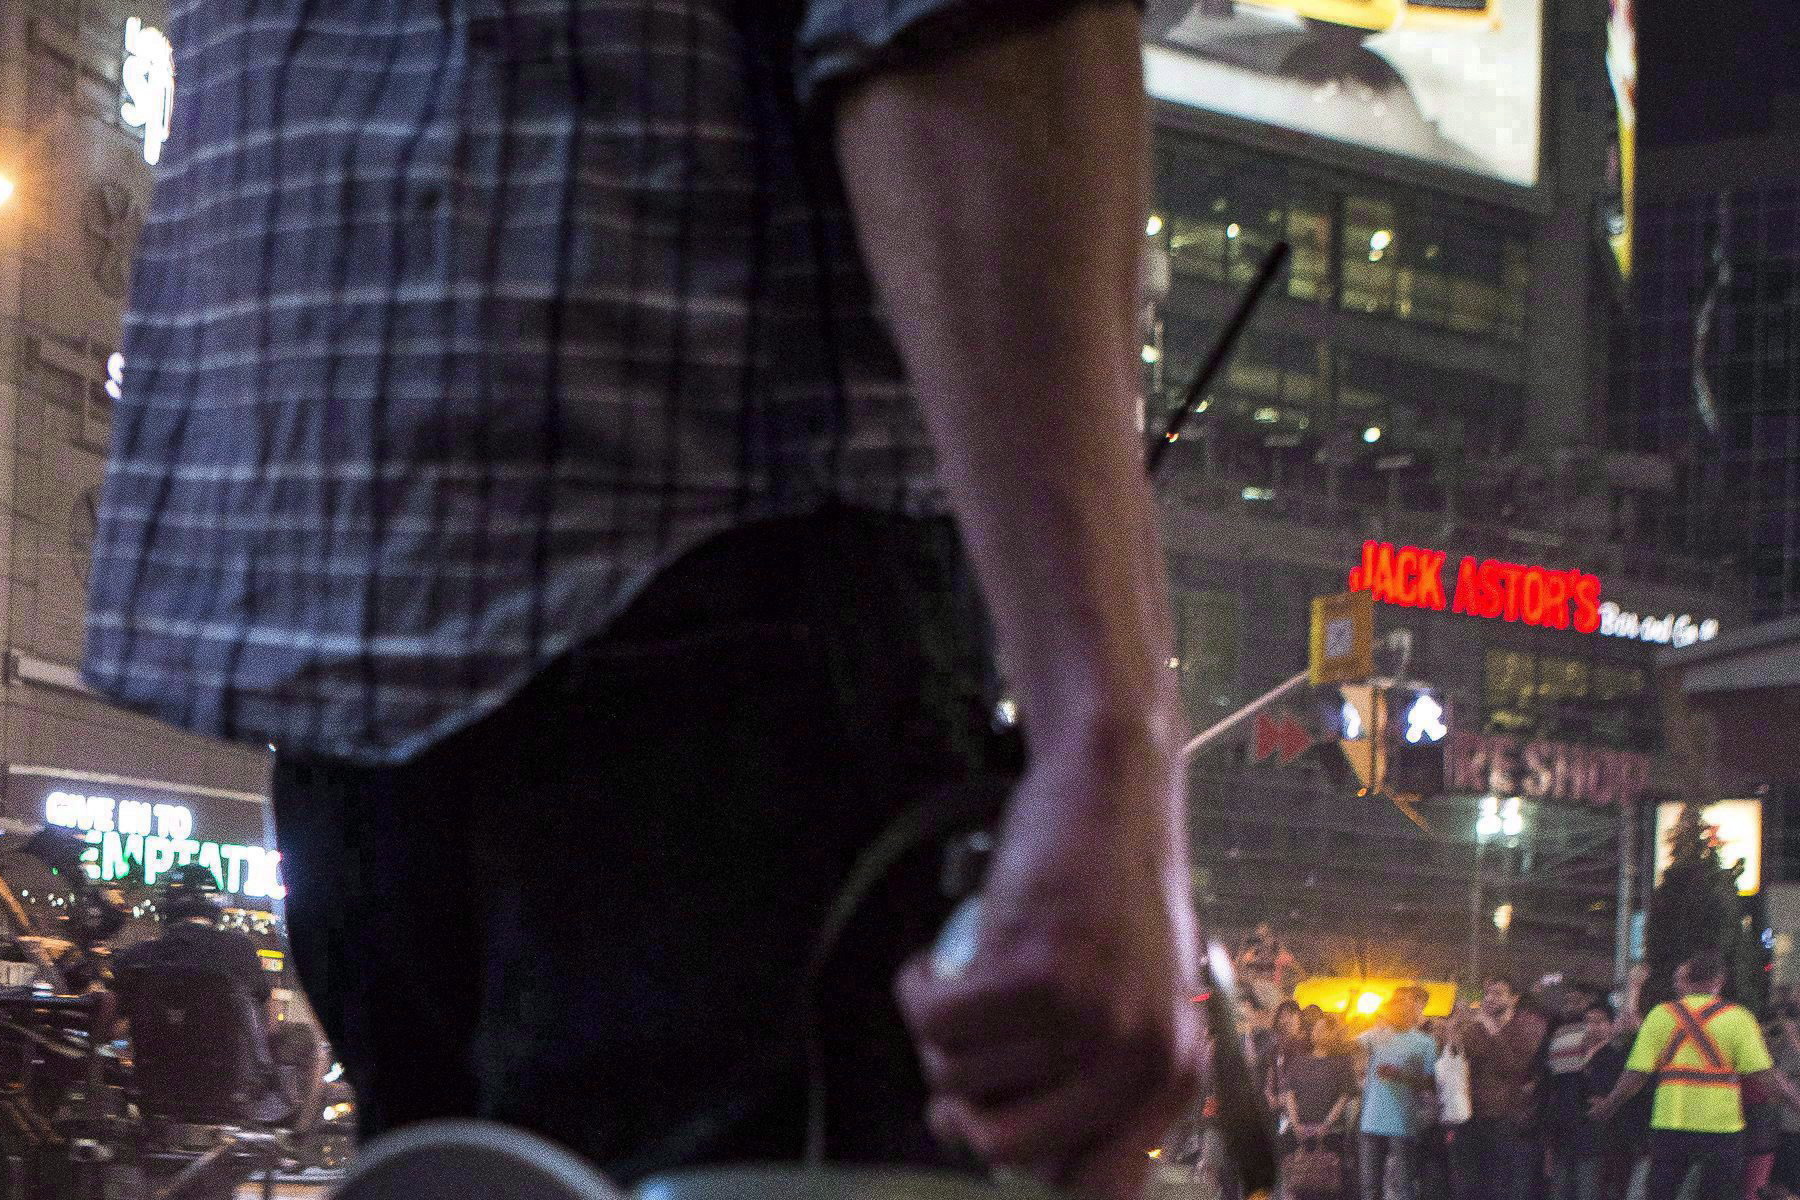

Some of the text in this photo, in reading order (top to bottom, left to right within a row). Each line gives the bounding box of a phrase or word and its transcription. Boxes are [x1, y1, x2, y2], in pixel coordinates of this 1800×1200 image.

[1350, 540, 1447, 611] JACK
[1453, 555, 1601, 634] ASTOR'S
[153, 803, 193, 841] TO
